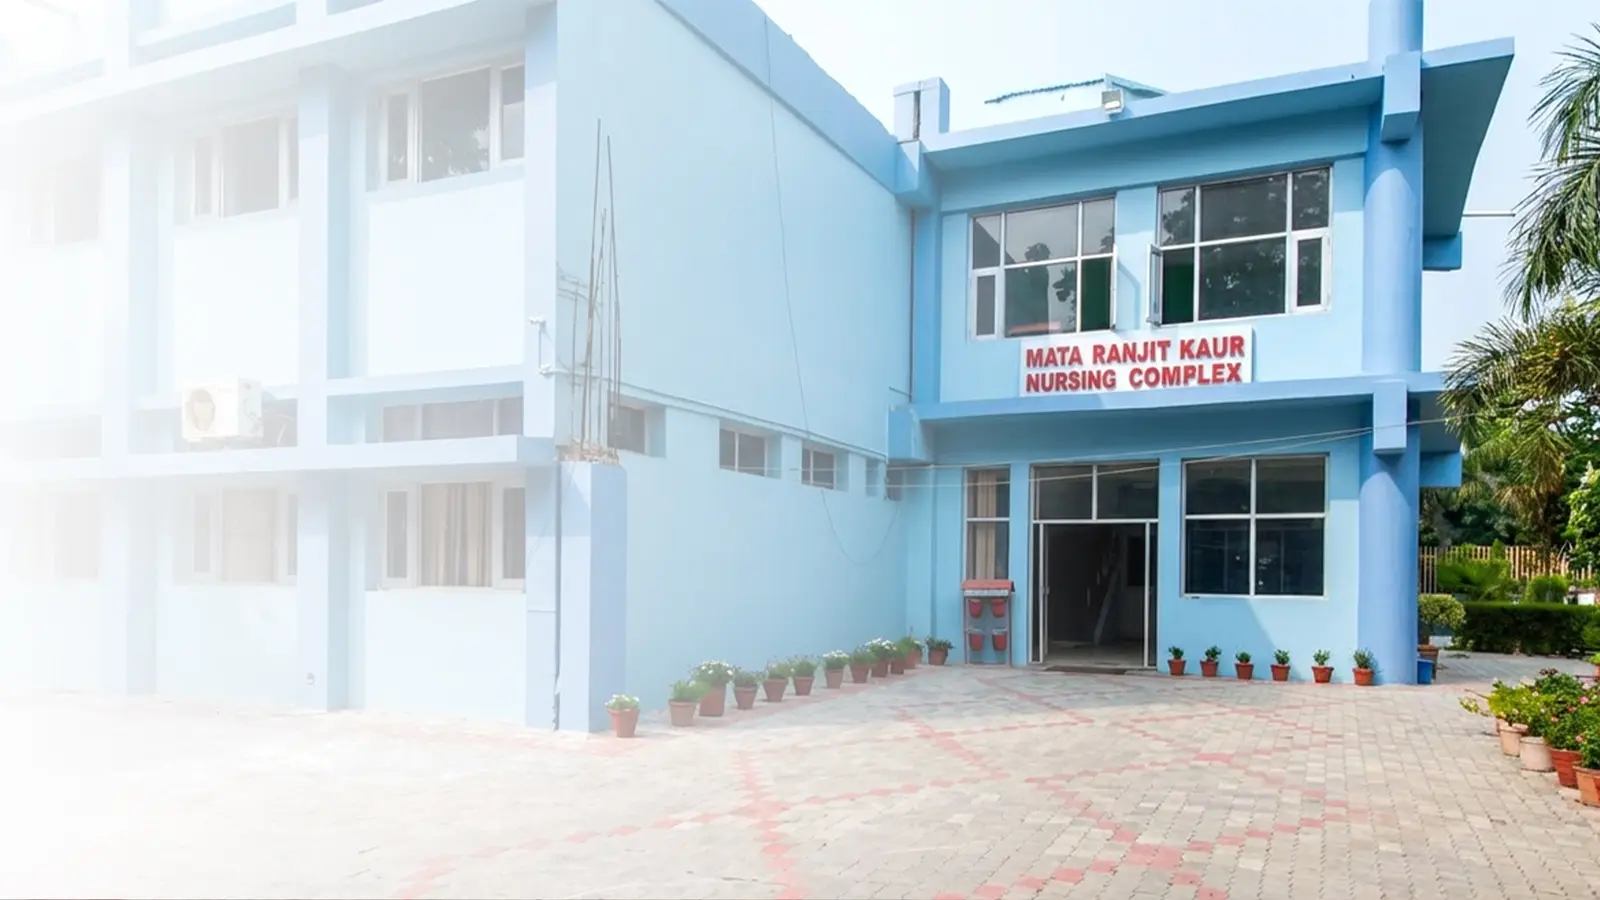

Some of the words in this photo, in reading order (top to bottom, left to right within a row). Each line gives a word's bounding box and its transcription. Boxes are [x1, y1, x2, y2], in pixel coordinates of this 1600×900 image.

[1026, 346, 1083, 368] MATA
[1092, 339, 1171, 365] RANJIT
[1179, 335, 1245, 359] KAUR
[1026, 370, 1116, 392] NURSING
[1128, 362, 1242, 389] COMPLEX
